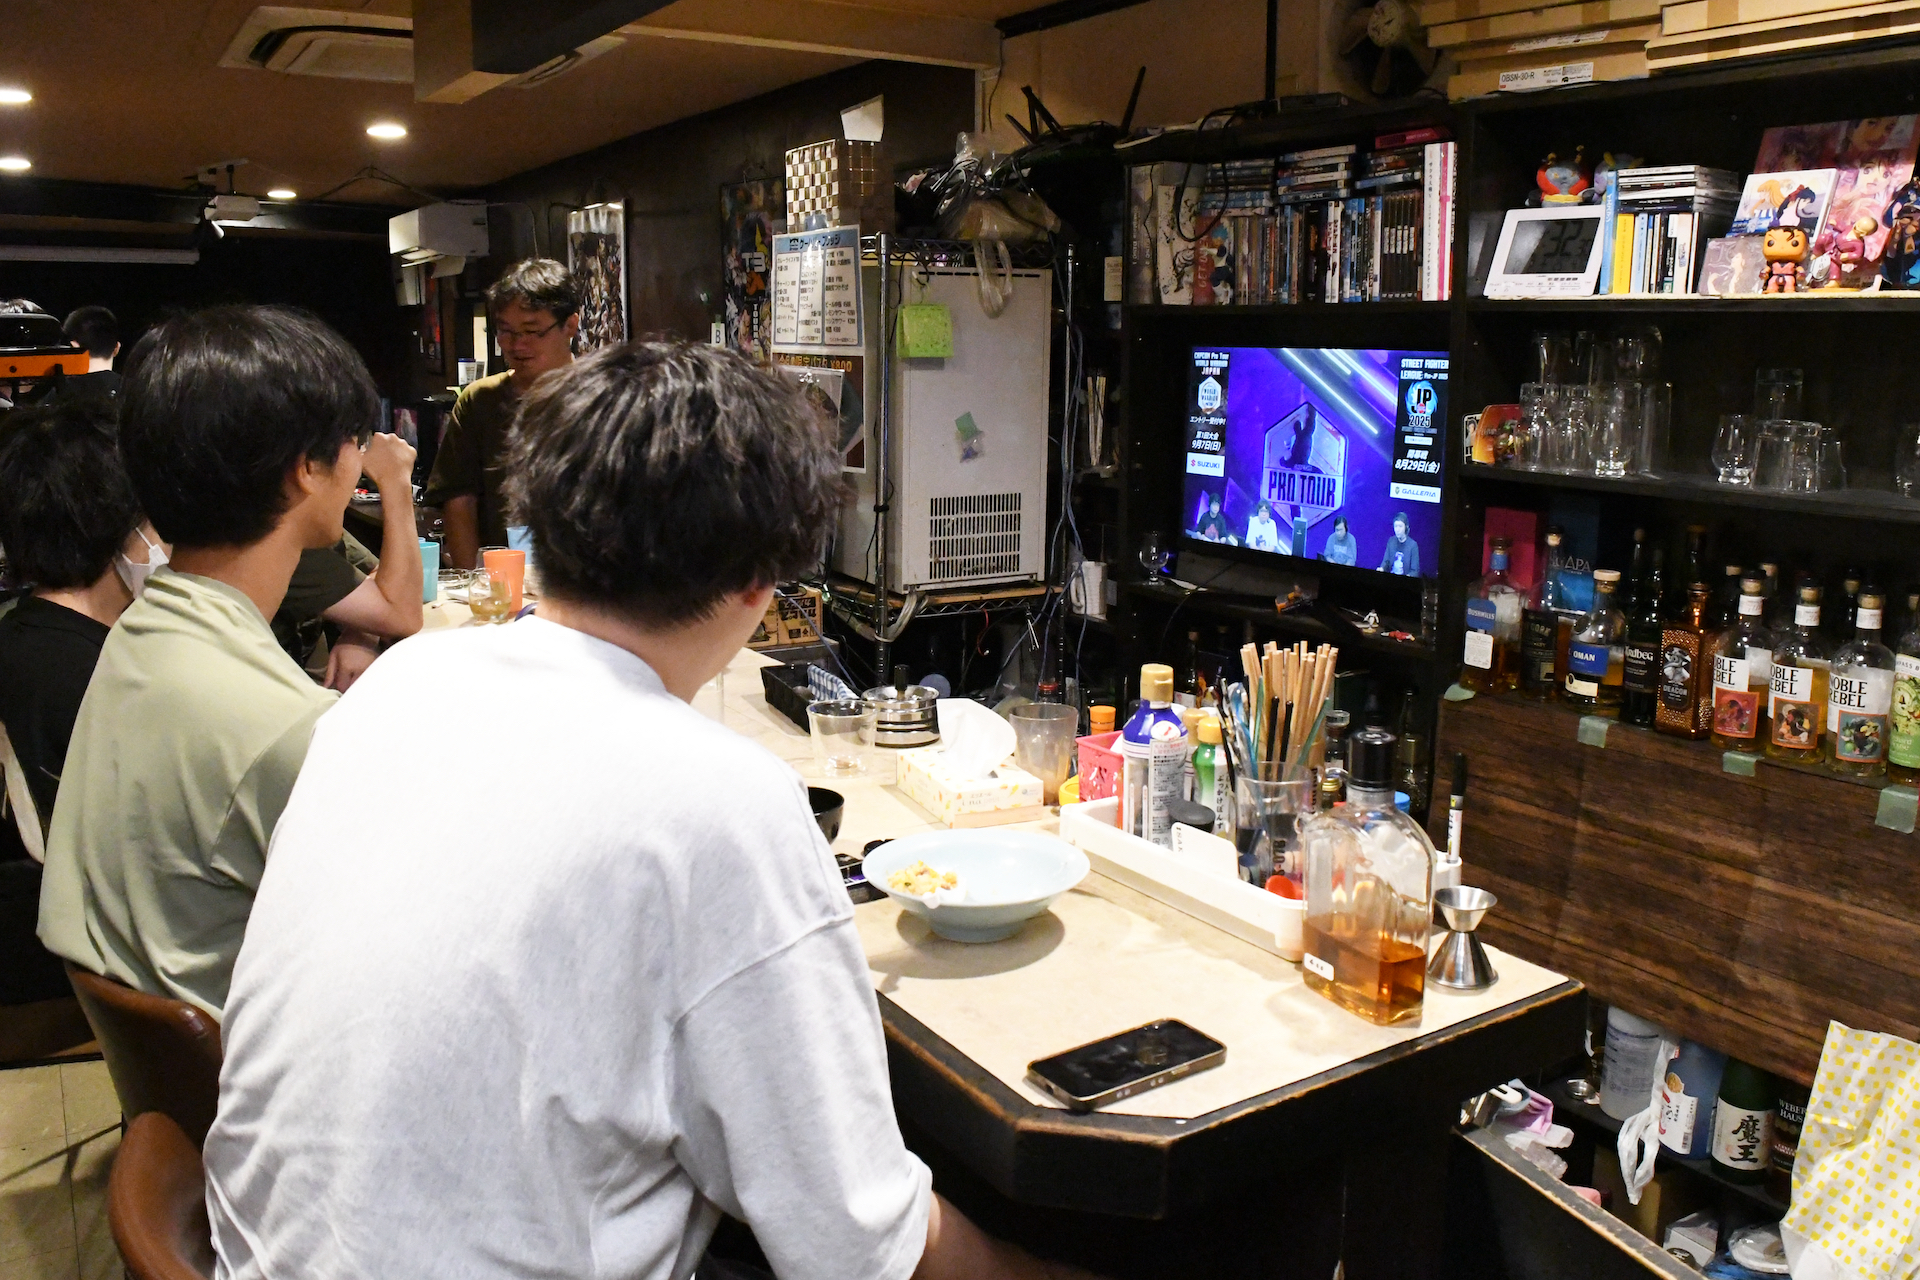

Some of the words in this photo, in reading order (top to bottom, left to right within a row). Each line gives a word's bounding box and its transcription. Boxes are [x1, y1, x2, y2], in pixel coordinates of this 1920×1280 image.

[1401, 358, 1424, 368] STREET
[1424, 359, 1449, 370] FIGHTER
[1409, 414, 1432, 428] 2025
[1197, 460, 1220, 469] SUZUKI
[1395, 459, 1441, 474] 8月29日(金)
[1268, 470, 1296, 502] PRO
[1300, 474, 1336, 508] TOUR
[1402, 488, 1437, 498] GALLERIA
[1468, 607, 1496, 621] BUSHMILLS
[1829, 675, 1868, 695] NOBLE
[1829, 691, 1866, 709] REBEL
[1729, 1114, 1761, 1163] 魔王
